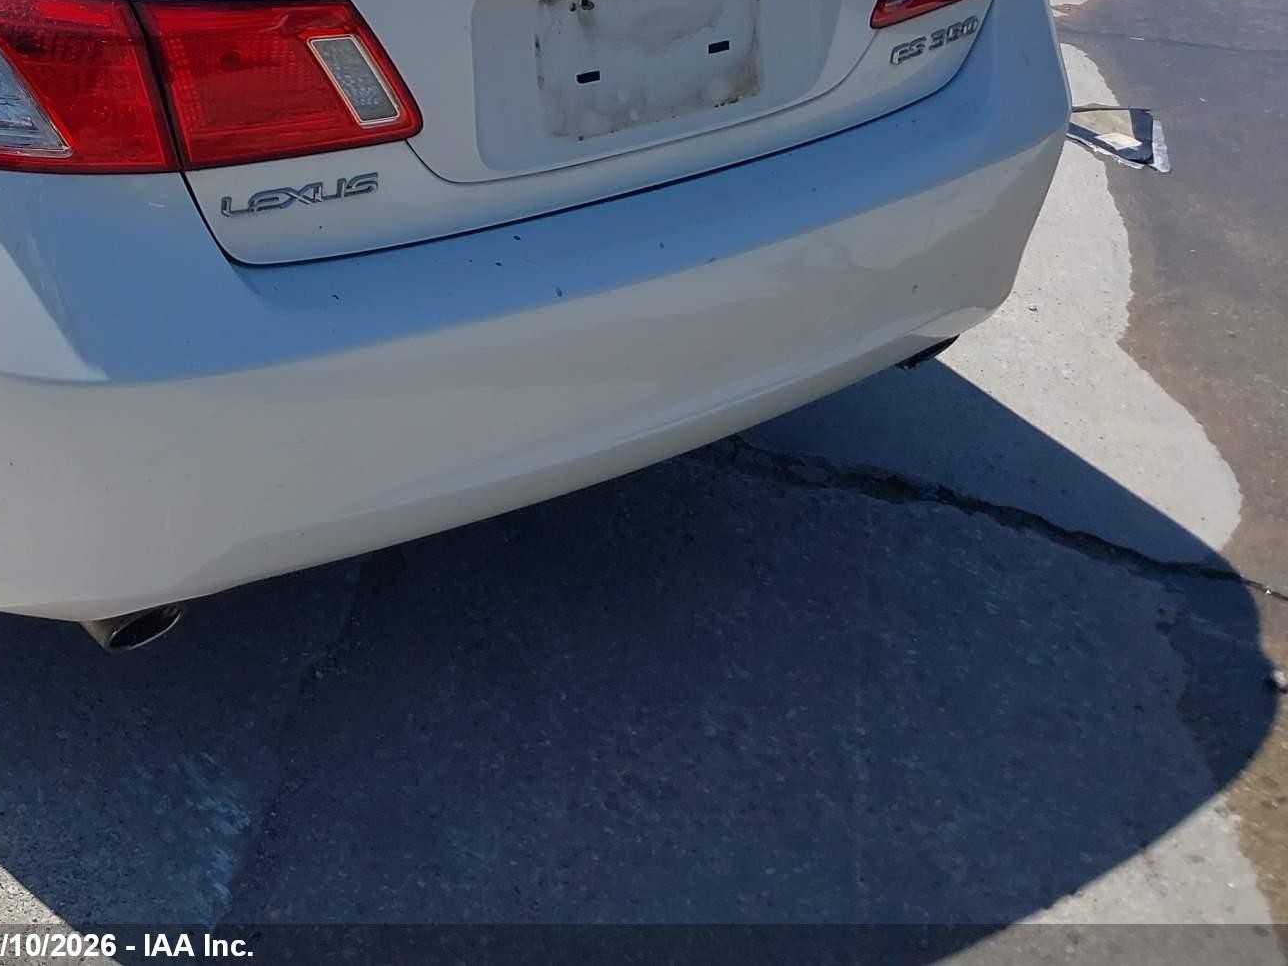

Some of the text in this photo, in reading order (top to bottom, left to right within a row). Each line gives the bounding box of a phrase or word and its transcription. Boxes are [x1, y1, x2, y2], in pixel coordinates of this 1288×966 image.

[890, 15, 980, 65] ES 350
[220, 171, 380, 218] LEXUS
